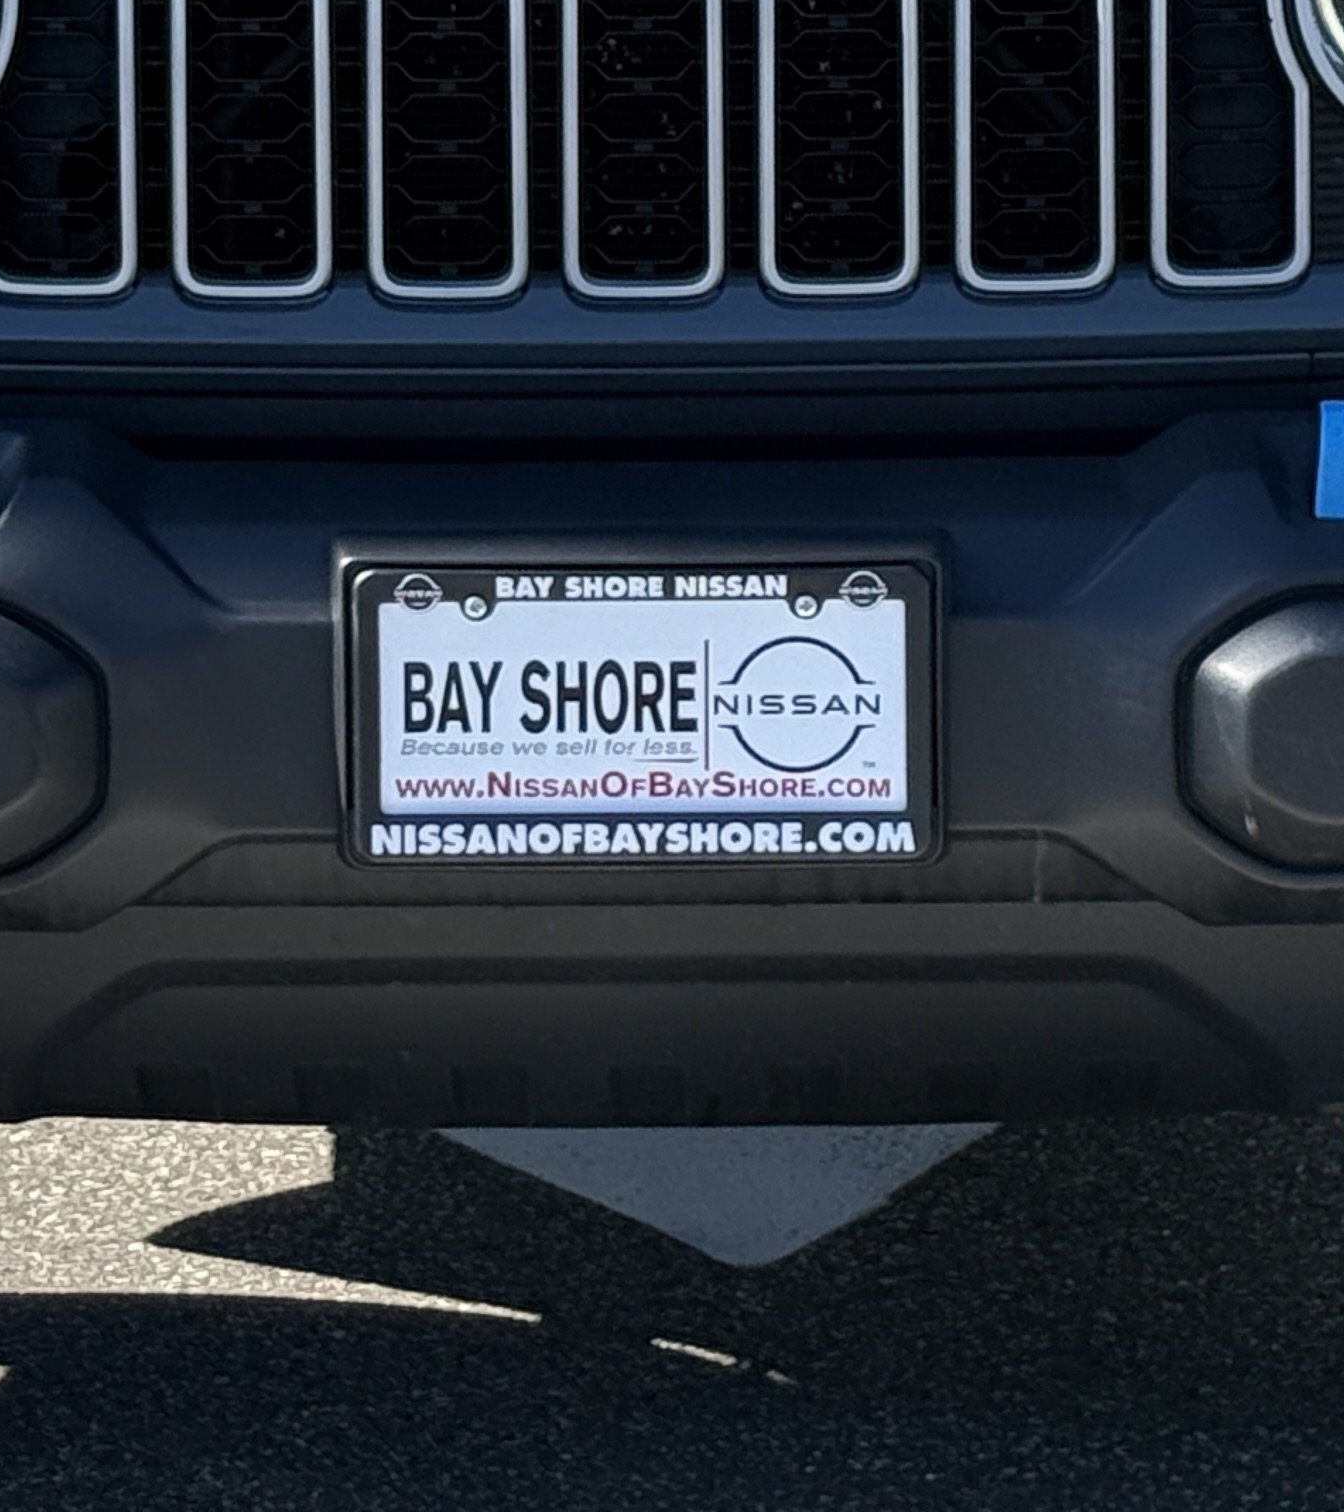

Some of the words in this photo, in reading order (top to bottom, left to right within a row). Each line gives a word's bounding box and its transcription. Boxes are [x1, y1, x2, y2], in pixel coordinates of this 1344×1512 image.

[495, 576, 554, 598] BAY
[564, 575, 664, 599] SHORE
[674, 574, 788, 598] NISSAN
[403, 660, 503, 734] BAY
[520, 658, 699, 735] SHORE
[713, 694, 882, 716] NISSAN
[400, 738, 504, 756] Because
[512, 743, 548, 756] we
[556, 738, 597, 756] sell
[605, 738, 636, 756] for
[370, 820, 916, 856] NISSANOFBAYSHORE.COM
